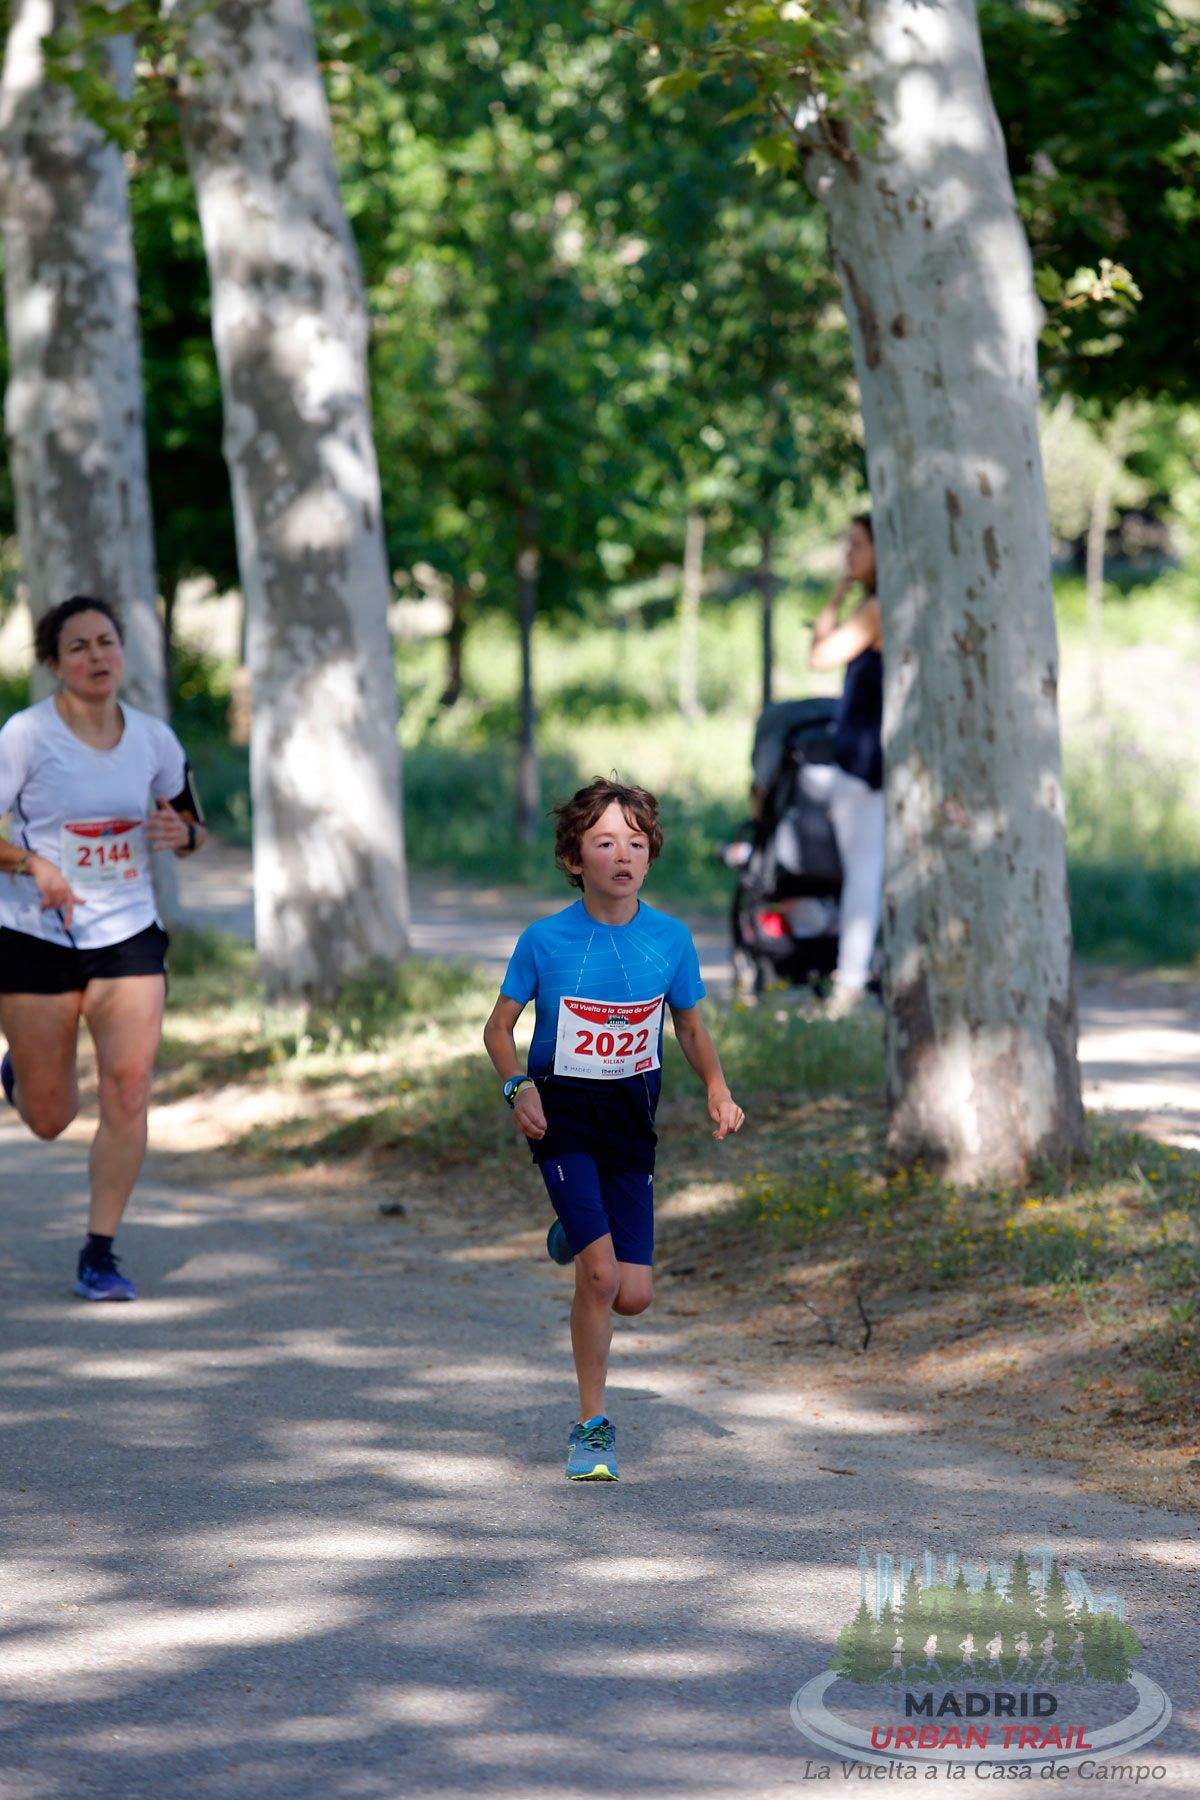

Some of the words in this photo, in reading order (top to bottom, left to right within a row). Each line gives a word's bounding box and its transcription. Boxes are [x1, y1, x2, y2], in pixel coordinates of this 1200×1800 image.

[78, 842, 130, 867] 2144
[580, 1004, 601, 1013] Vuelta
[575, 1029, 649, 1057] 2022
